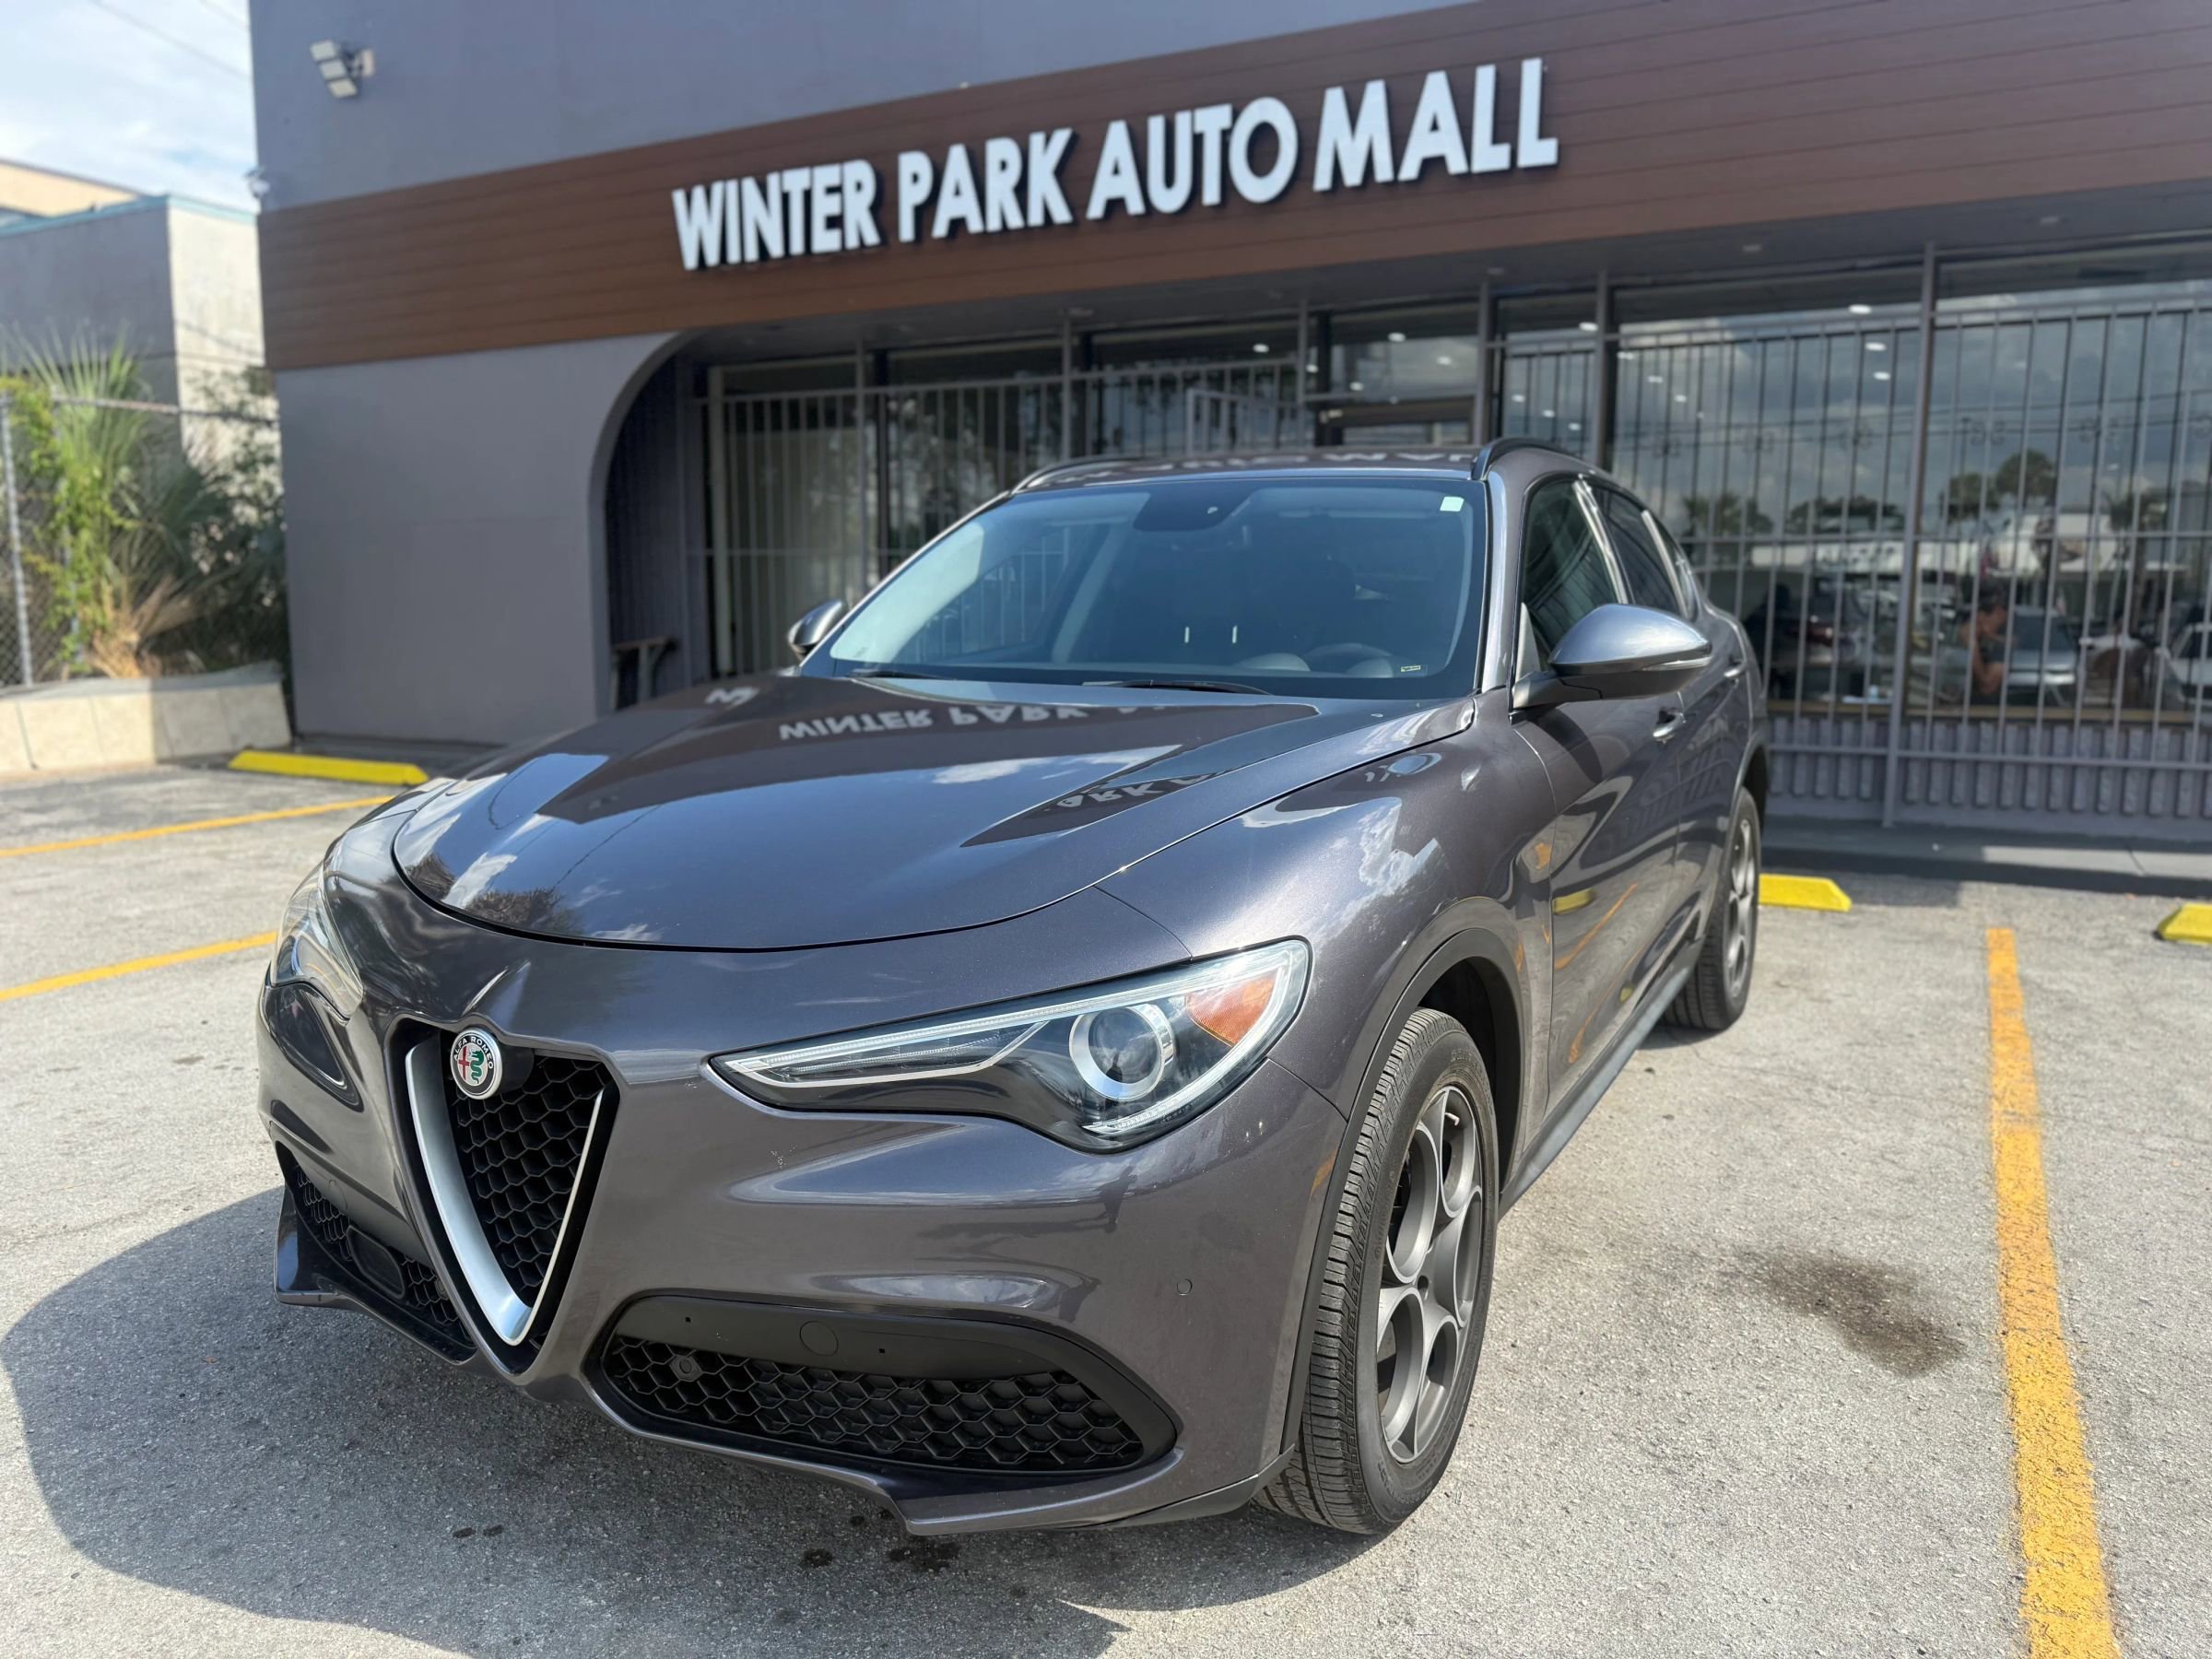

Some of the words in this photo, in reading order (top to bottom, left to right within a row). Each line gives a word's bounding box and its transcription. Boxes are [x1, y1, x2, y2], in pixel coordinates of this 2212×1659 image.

[672, 160, 879, 270] WINTER
[898, 128, 1072, 242] PARK
[1086, 96, 1299, 219] AUTO
[1312, 57, 1559, 192] MALL
[453, 1038, 468, 1062] ALFA
[470, 1036, 494, 1069] ROMEO
